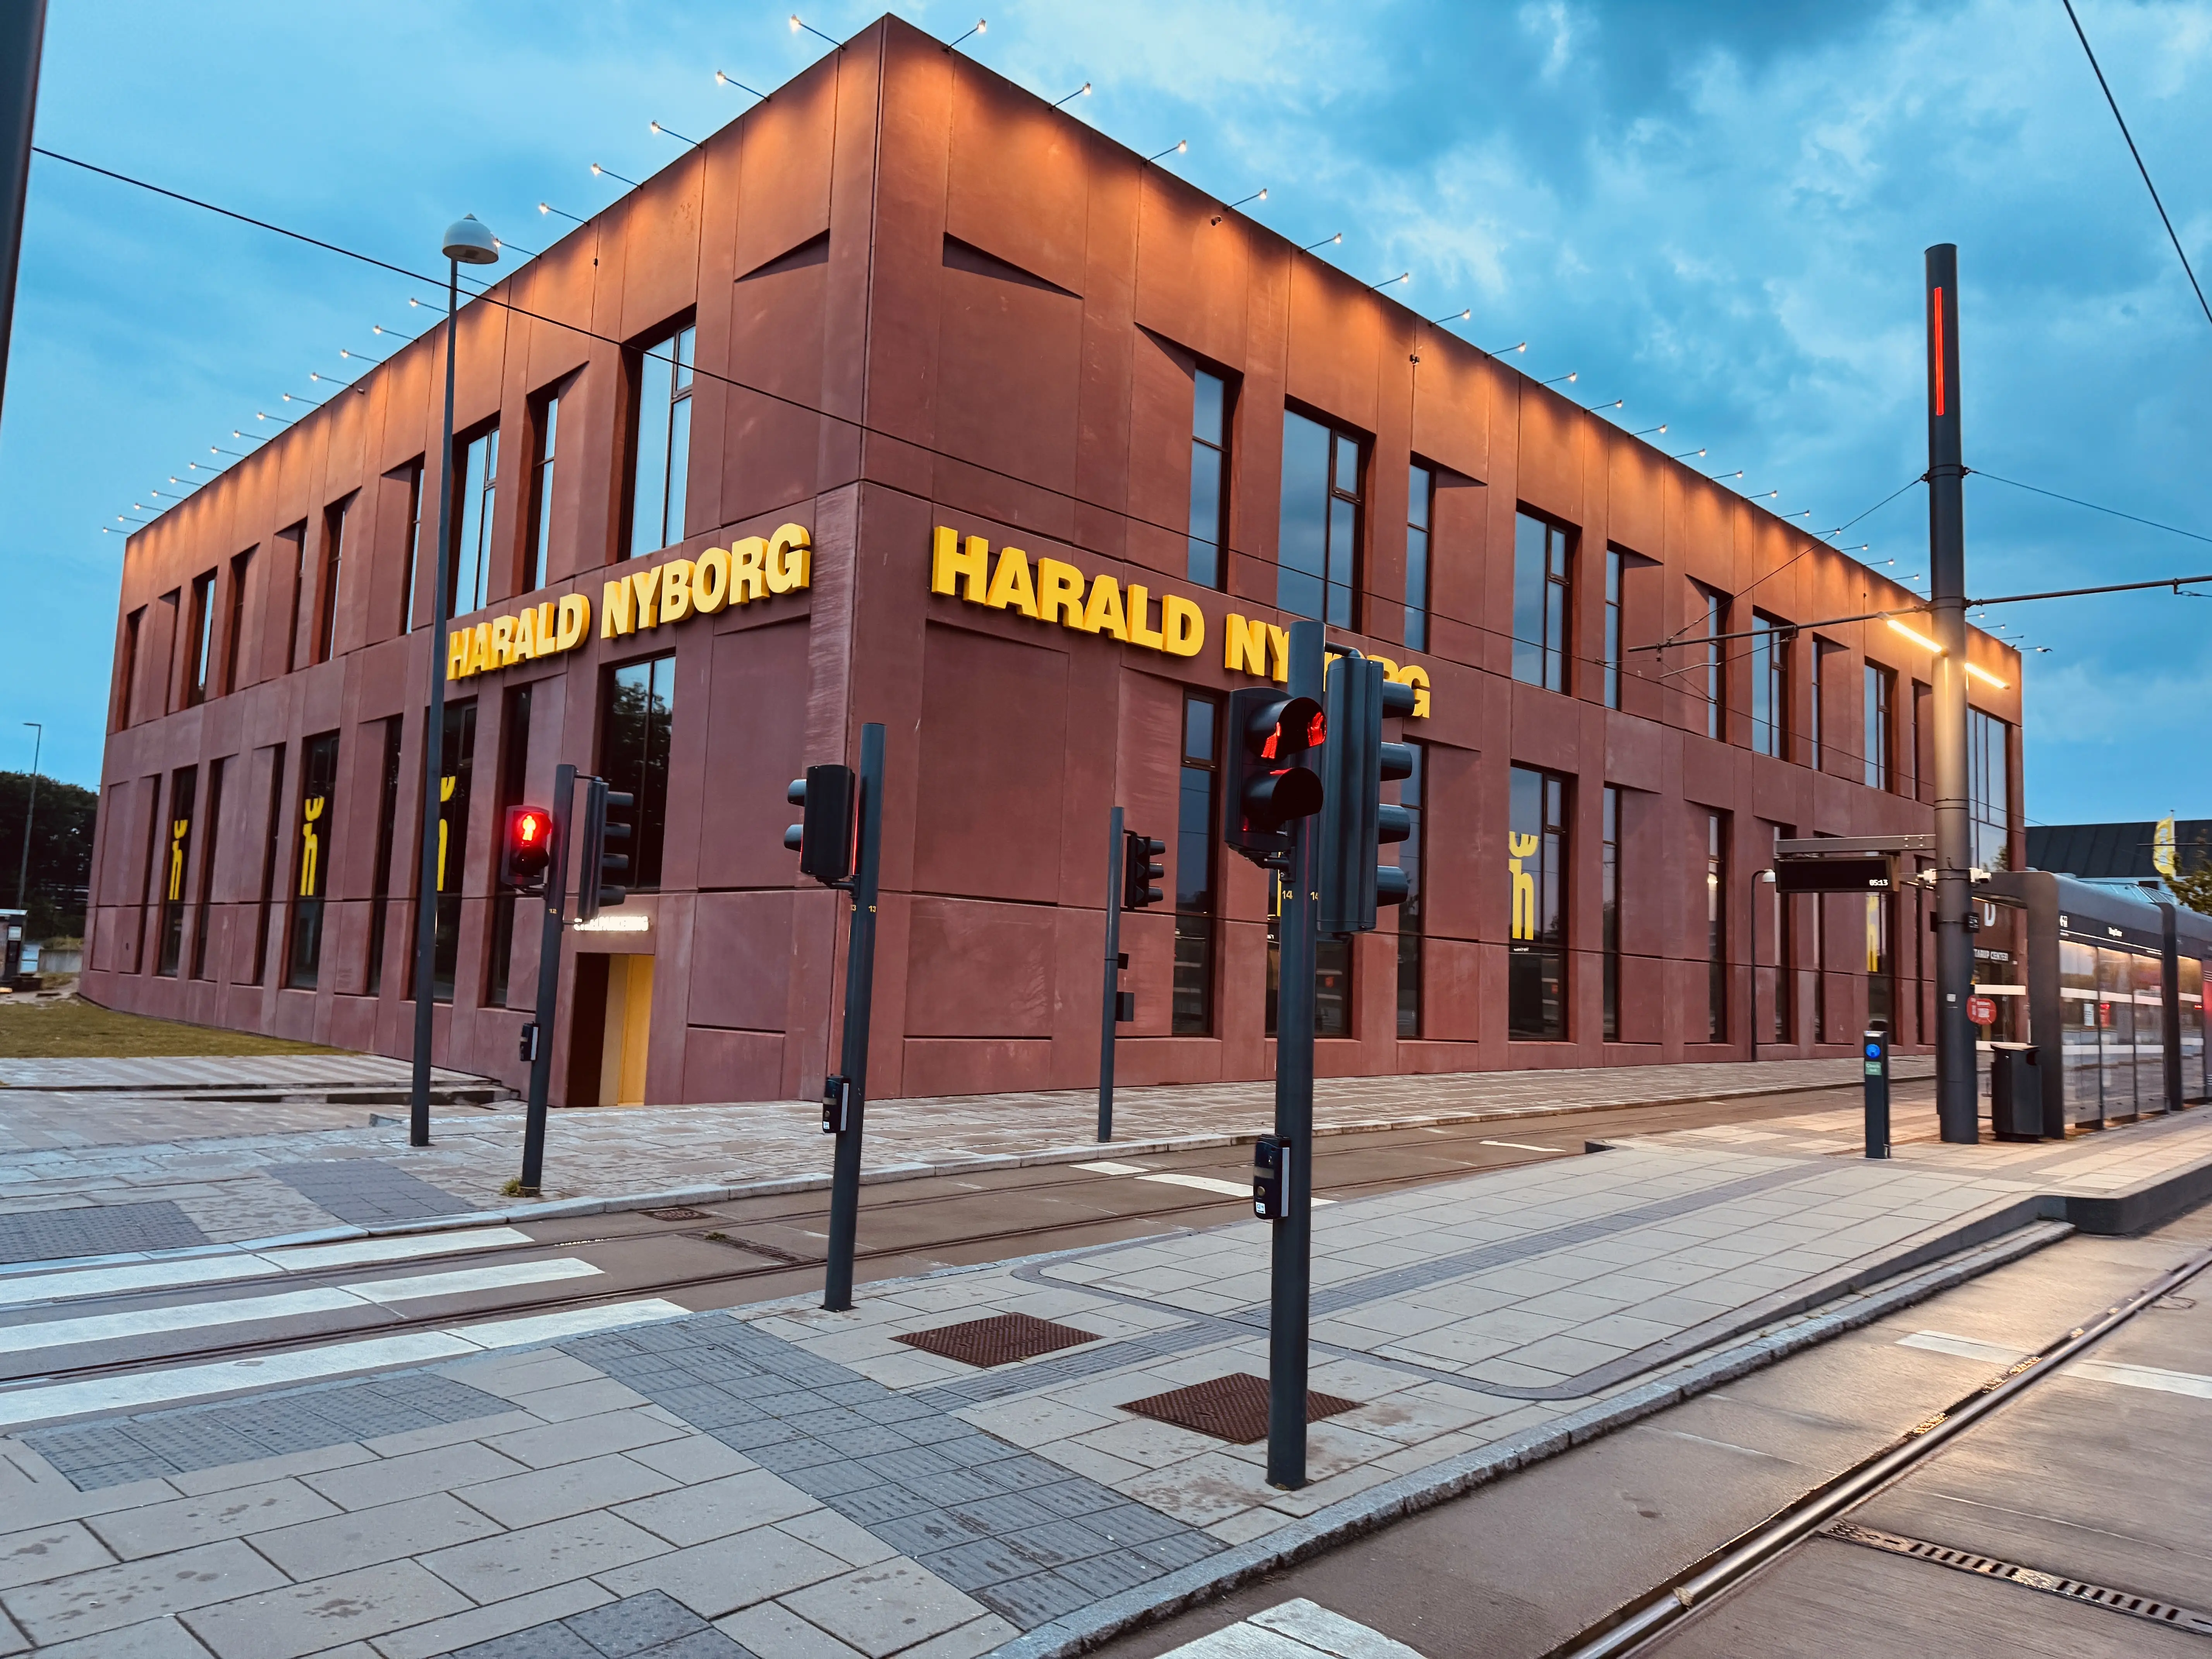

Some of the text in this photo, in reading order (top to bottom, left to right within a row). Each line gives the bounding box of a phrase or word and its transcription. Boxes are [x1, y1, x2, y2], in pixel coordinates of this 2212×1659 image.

[447, 523, 811, 680] HARALD NYBORG
[932, 526, 1205, 656] HARALD
[1282, 890, 1293, 899] 14
